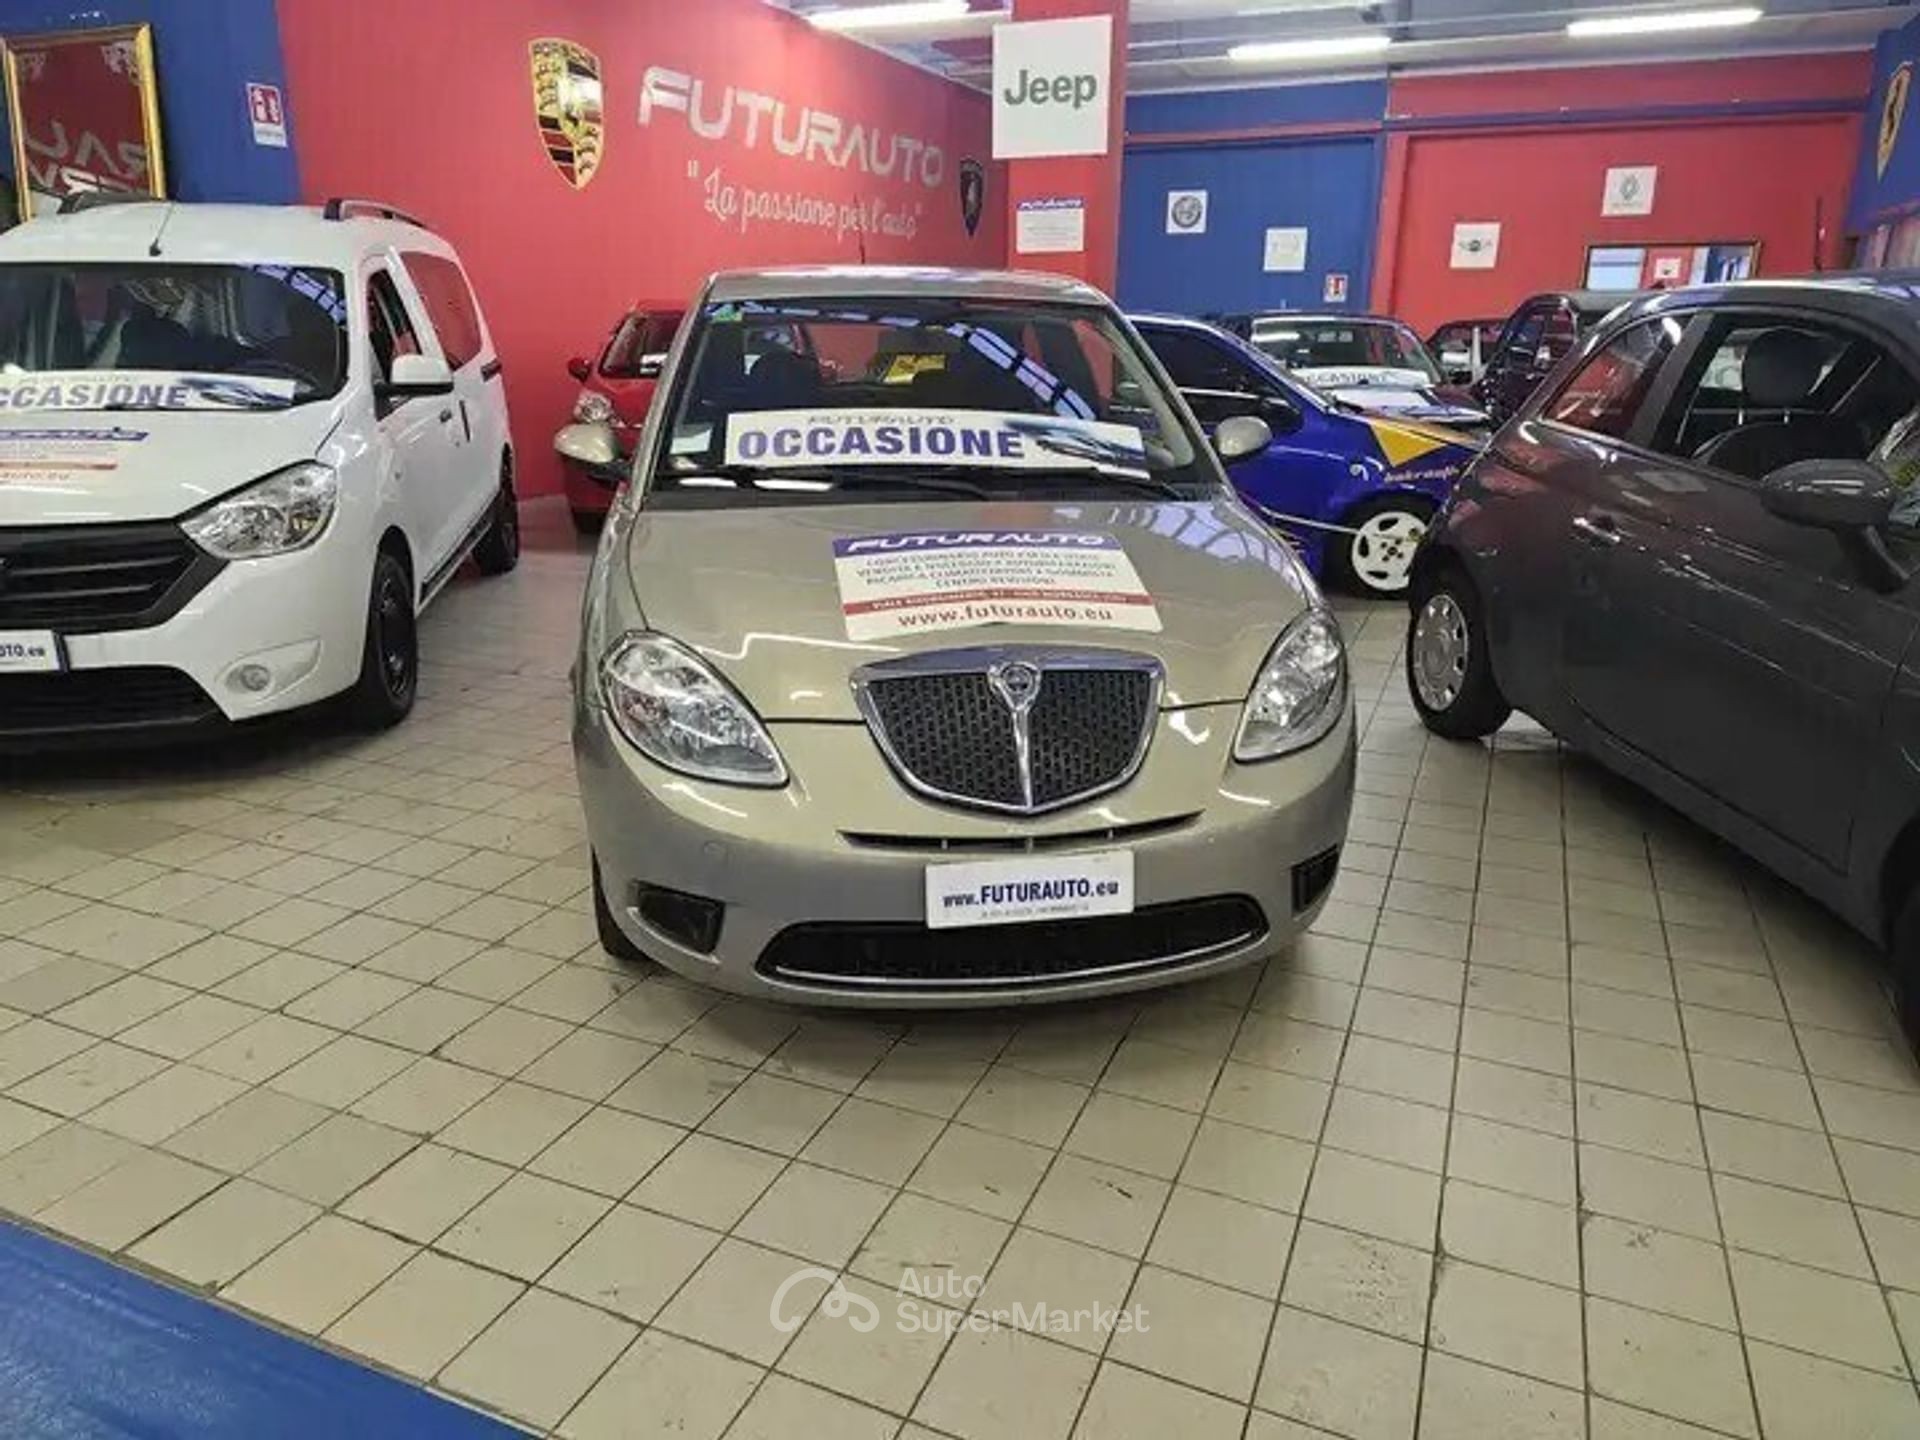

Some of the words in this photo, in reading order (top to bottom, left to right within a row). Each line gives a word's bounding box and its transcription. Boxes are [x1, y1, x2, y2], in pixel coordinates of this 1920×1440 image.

[1004, 69, 1097, 110] Jeep
[638, 66, 944, 188] FUTURAUTO
[741, 188, 835, 234] passione
[738, 427, 1025, 458] OCCASIONE
[847, 532, 1104, 552] FUTURAUTO
[898, 603, 1113, 628] www.futurauto.eu
[942, 878, 1119, 908] www.FUTURAUTO.eu
